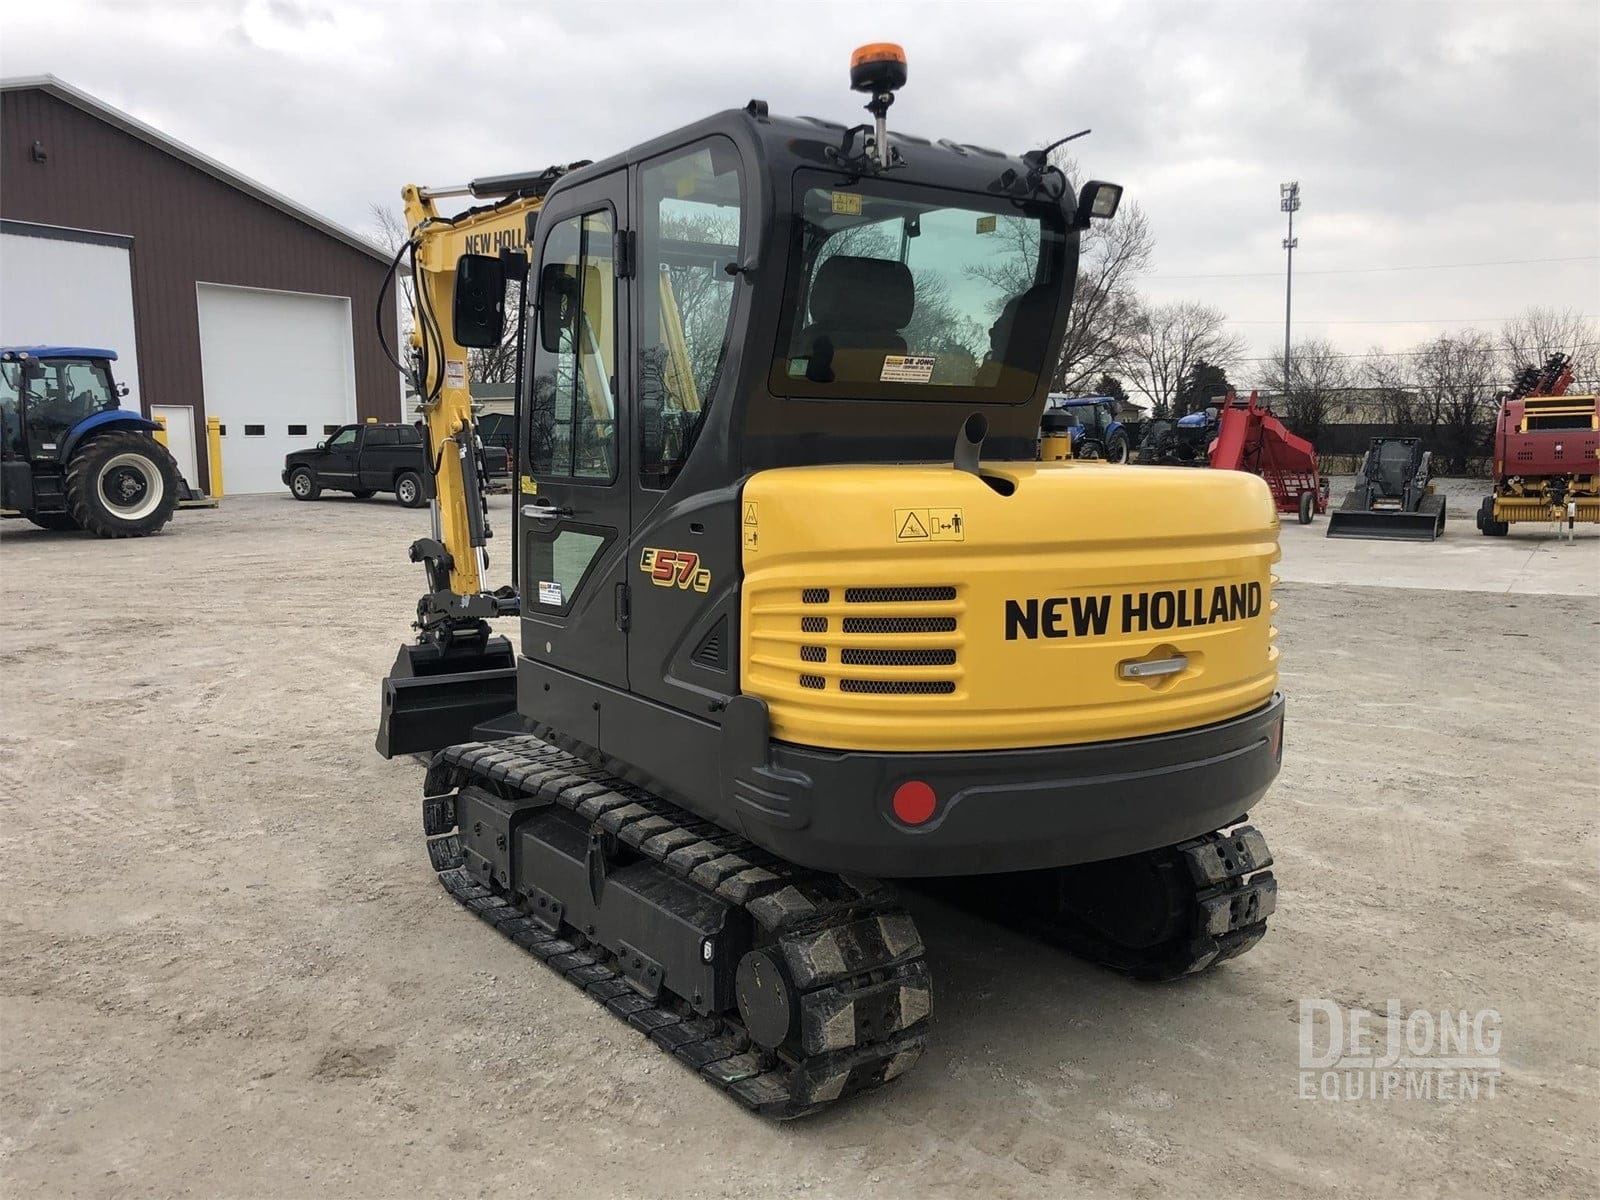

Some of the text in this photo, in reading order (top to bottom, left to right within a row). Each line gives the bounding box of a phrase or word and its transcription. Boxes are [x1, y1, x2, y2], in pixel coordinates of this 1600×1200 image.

[465, 232, 491, 254] NEW
[1005, 581, 1262, 640] NEW HOLLAND
